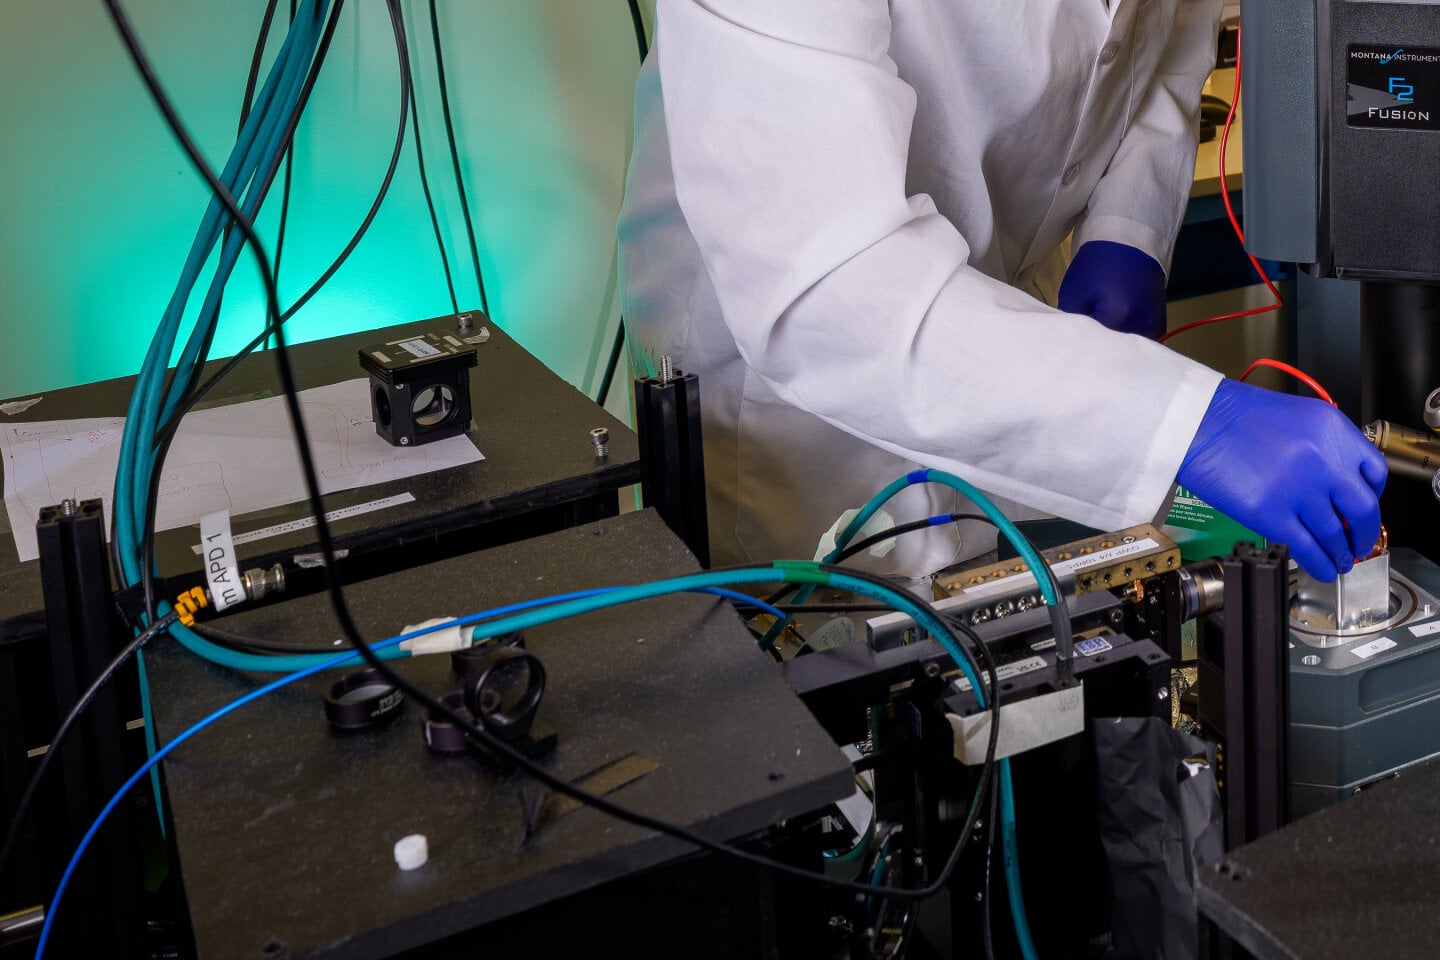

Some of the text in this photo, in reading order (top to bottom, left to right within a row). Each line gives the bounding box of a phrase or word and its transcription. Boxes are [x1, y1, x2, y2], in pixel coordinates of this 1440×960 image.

[1350, 52, 1391, 60] MONTANA
[1368, 107, 1429, 121] FUSION
[206, 532, 222, 542] 1
[1115, 544, 1141, 556] QWP
[208, 546, 231, 584] APD
